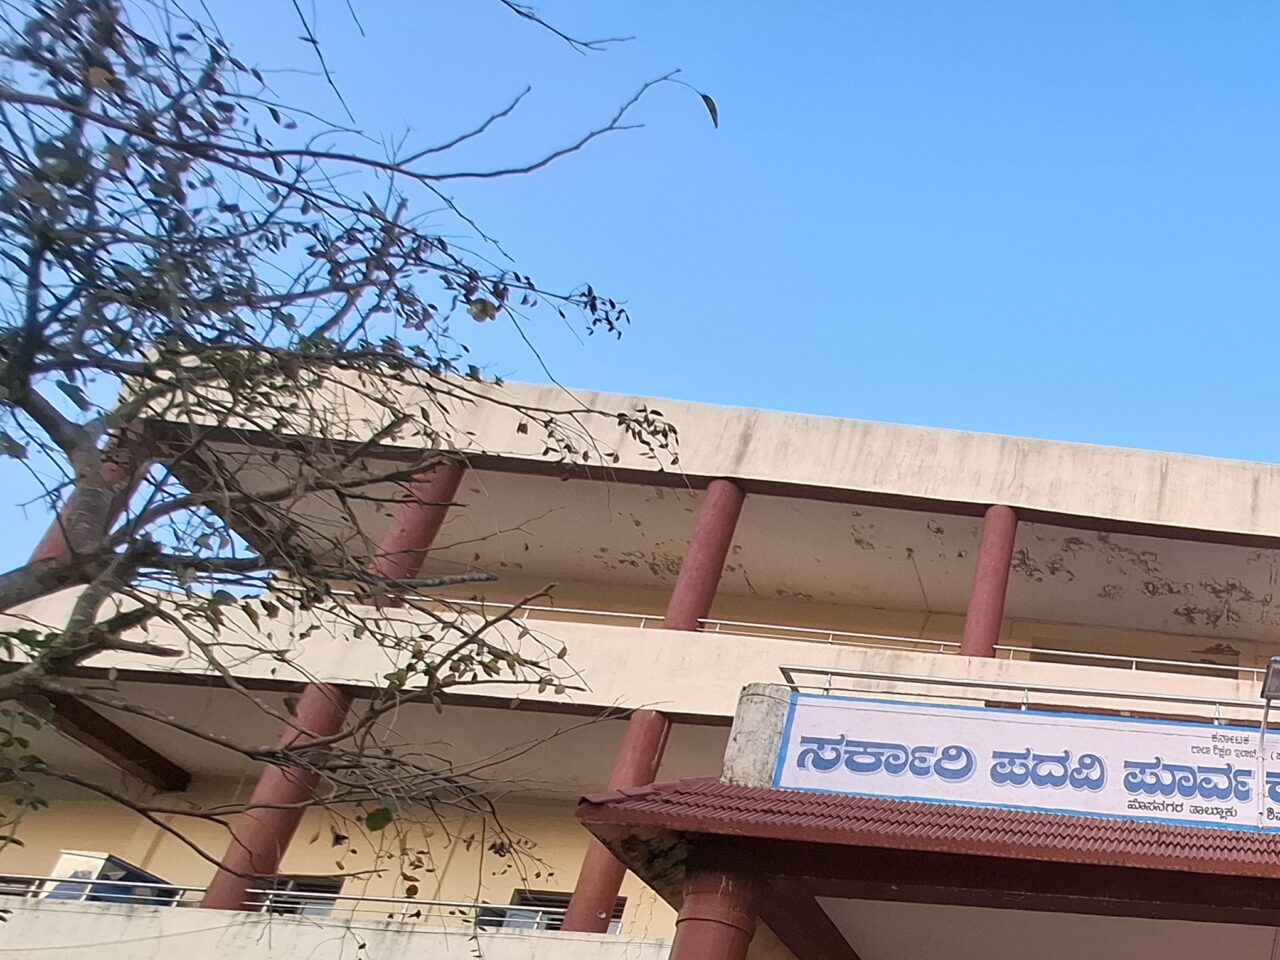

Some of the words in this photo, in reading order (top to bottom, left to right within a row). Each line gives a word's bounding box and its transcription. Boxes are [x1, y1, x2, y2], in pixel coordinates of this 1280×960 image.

[1211, 732, 1250, 745] ಕರ್ನಾಟಕ
[796, 734, 975, 782] ಸರ್ಕಾರಿ
[992, 748, 1106, 792] ಪದವಿ
[1124, 757, 1253, 801] ಪೂರ್ವ
[1127, 798, 1184, 813] ಹೊಸನಗರ
[1189, 804, 1238, 820] ತಾಲ್ಲೂಕು
